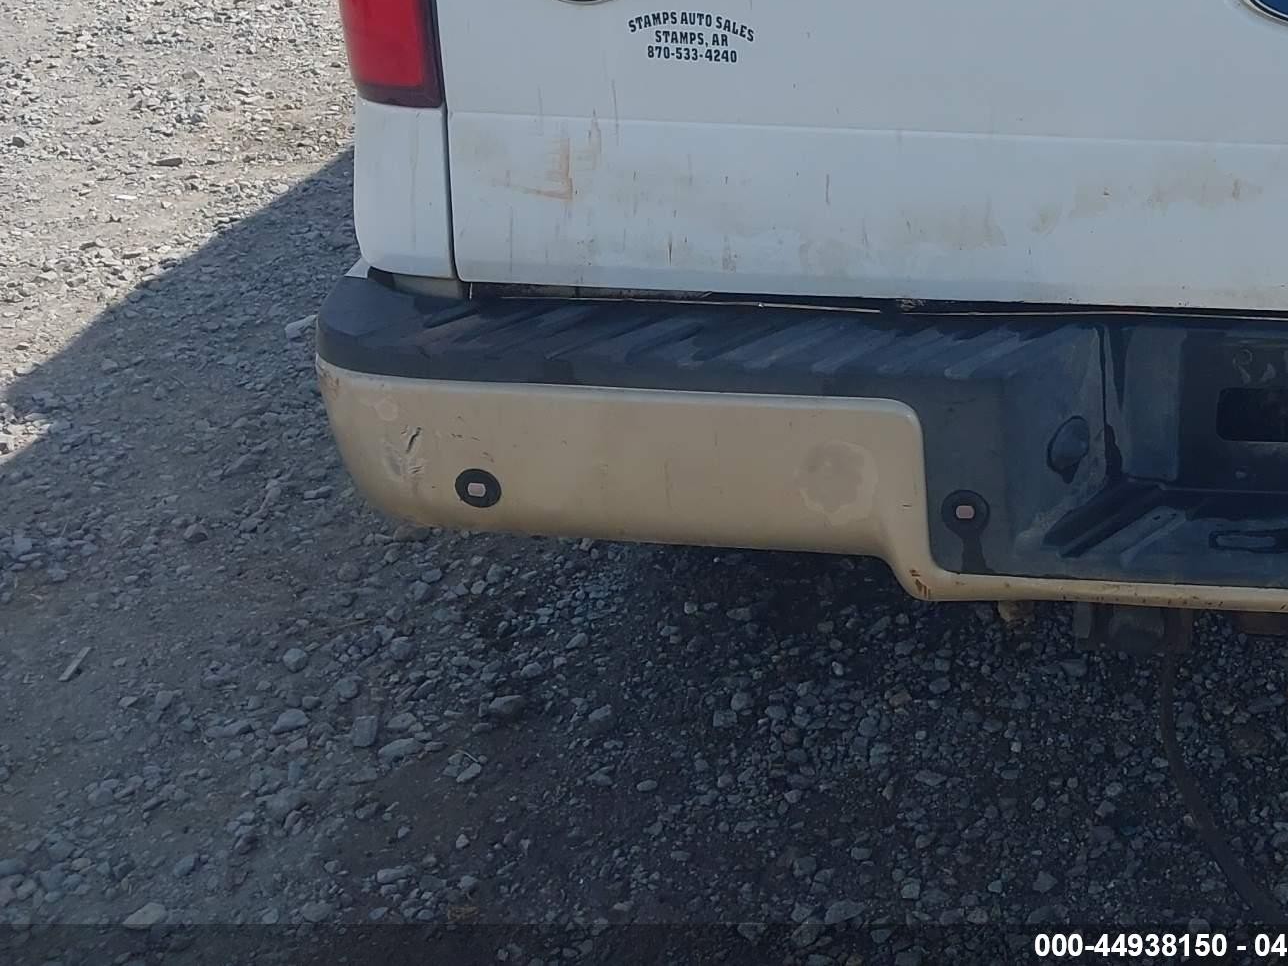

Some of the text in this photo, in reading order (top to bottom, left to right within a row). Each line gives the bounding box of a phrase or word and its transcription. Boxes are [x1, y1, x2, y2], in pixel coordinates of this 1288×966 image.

[628, 12, 755, 42] STAMPS AUTO SALES
[655, 30, 729, 48] STAMPS, AR
[647, 46, 737, 63] 870-533-4240
